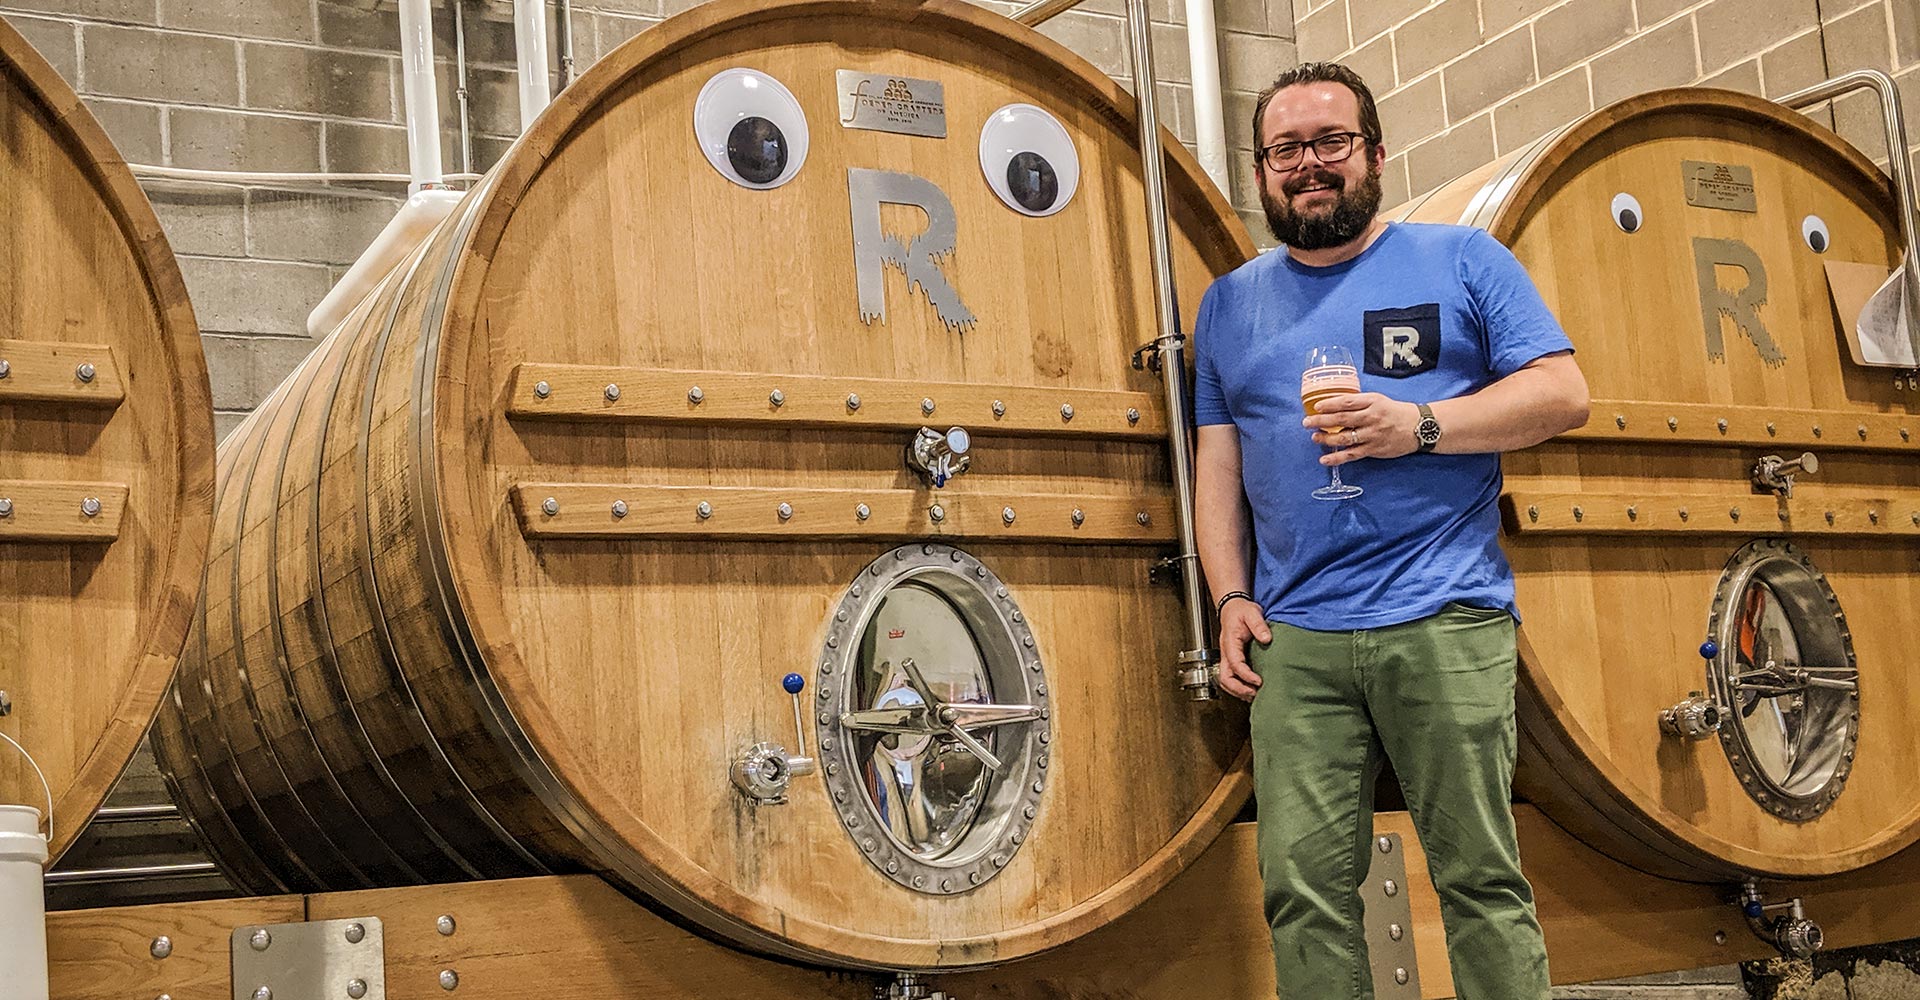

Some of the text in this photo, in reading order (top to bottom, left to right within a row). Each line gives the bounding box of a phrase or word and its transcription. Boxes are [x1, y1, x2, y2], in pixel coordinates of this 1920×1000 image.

[846, 168, 978, 335] R
[1692, 237, 1787, 369] R
[1383, 326, 1423, 369] R
